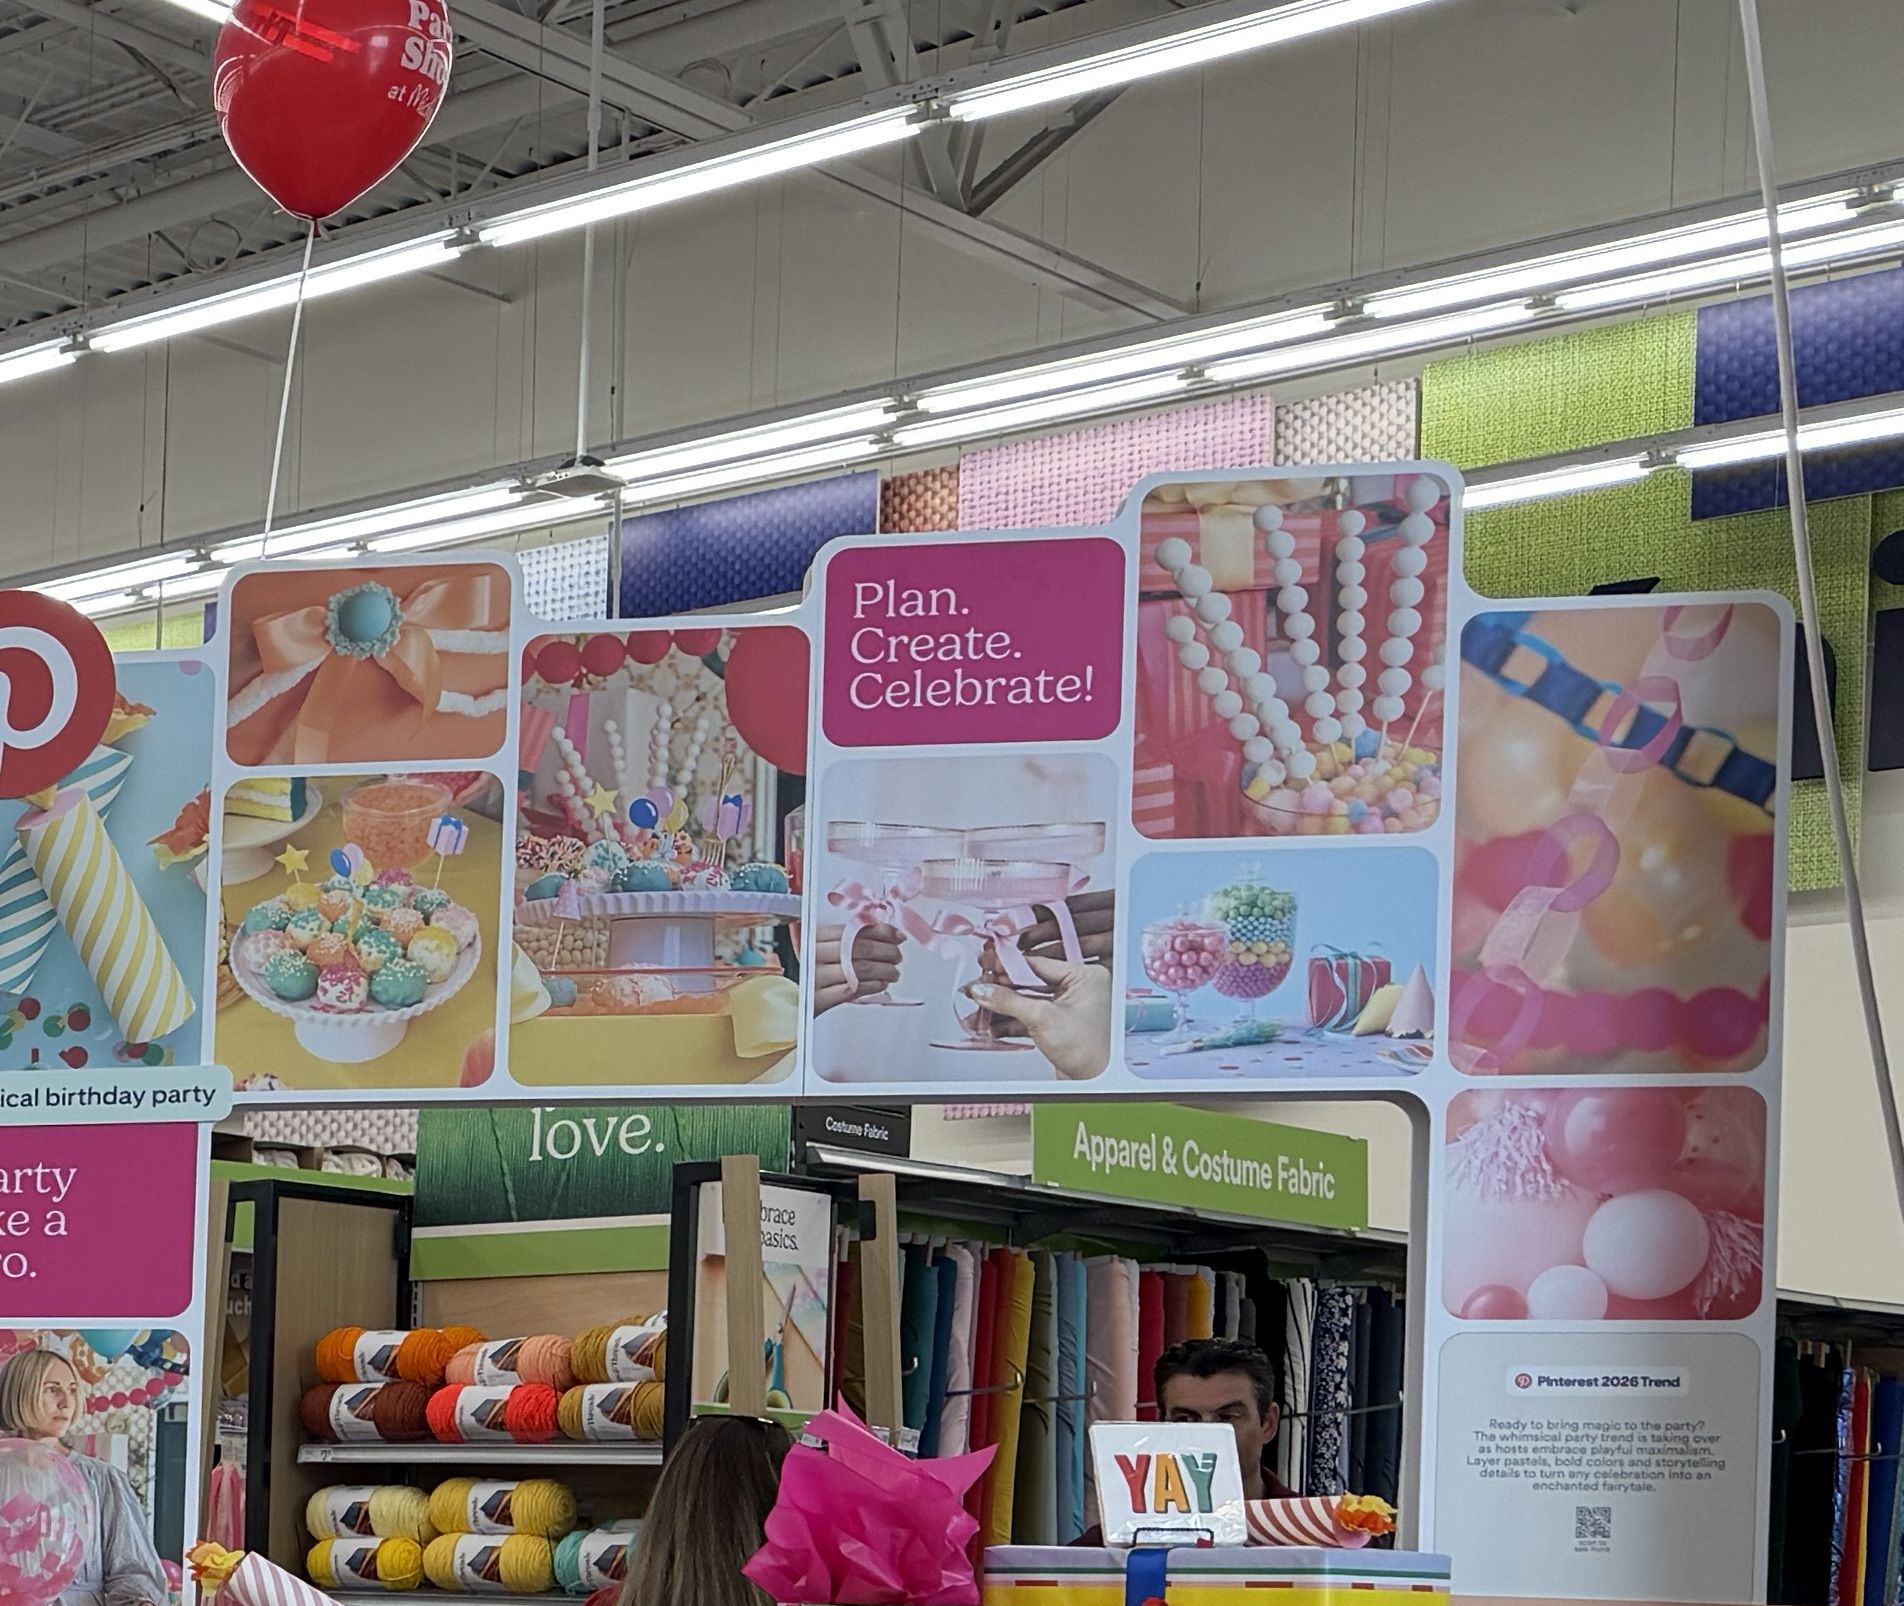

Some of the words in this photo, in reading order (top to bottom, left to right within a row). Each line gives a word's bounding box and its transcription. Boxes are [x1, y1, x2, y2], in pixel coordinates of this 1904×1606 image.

[853, 579, 970, 619] Plan.
[850, 627, 1022, 664] Create.
[849, 665, 1094, 709] Celebrate!
[45, 1085, 146, 1108] birthday
[152, 1085, 217, 1108] party
[528, 1107, 666, 1162] love.
[825, 1115, 861, 1137] Costume
[863, 1121, 890, 1142] Fabric
[1073, 1121, 1158, 1174] Apparel
[1162, 1139, 1178, 1171] &
[1182, 1139, 1274, 1189] Costume
[1277, 1155, 1337, 1200] Fabric
[43, 1209, 68, 1237] a
[1537, 1375, 1599, 1388] Pinterest
[1601, 1375, 1639, 1388] 2026
[1641, 1376, 1681, 1388] Trend
[1473, 1431, 1497, 1442] The
[1499, 1431, 1561, 1442] whimsical
[1564, 1433, 1597, 1444] party
[1601, 1432, 1634, 1443] trend
[1638, 1433, 1647, 1443] is
[1651, 1433, 1690, 1446] taking
[1693, 1435, 1721, 1443] over
[1489, 1420, 1528, 1431] Ready
[1530, 1421, 1543, 1430] to
[1546, 1420, 1579, 1433] bring
[1582, 1421, 1622, 1433] magic
[1624, 1421, 1638, 1431] to
[1640, 1421, 1661, 1431] the
[1664, 1421, 1705, 1434] party?
[1495, 1444, 1528, 1455] hosts
[1532, 1444, 1587, 1455] embrace
[1590, 1444, 1633, 1456] playful
[1635, 1444, 1715, 1456] maximalism.
[1466, 1457, 1501, 1468] Layer
[1503, 1457, 1551, 1468] pastels,
[1585, 1457, 1625, 1468] colors
[1654, 1458, 1726, 1470] storytelling
[1479, 1468, 1521, 1478] details
[1593, 1468, 1665, 1479] celebration
[1113, 1452, 1218, 1514] YAY
[1532, 1481, 1599, 1492] enchanted
[1601, 1481, 1656, 1492] fairytale.
